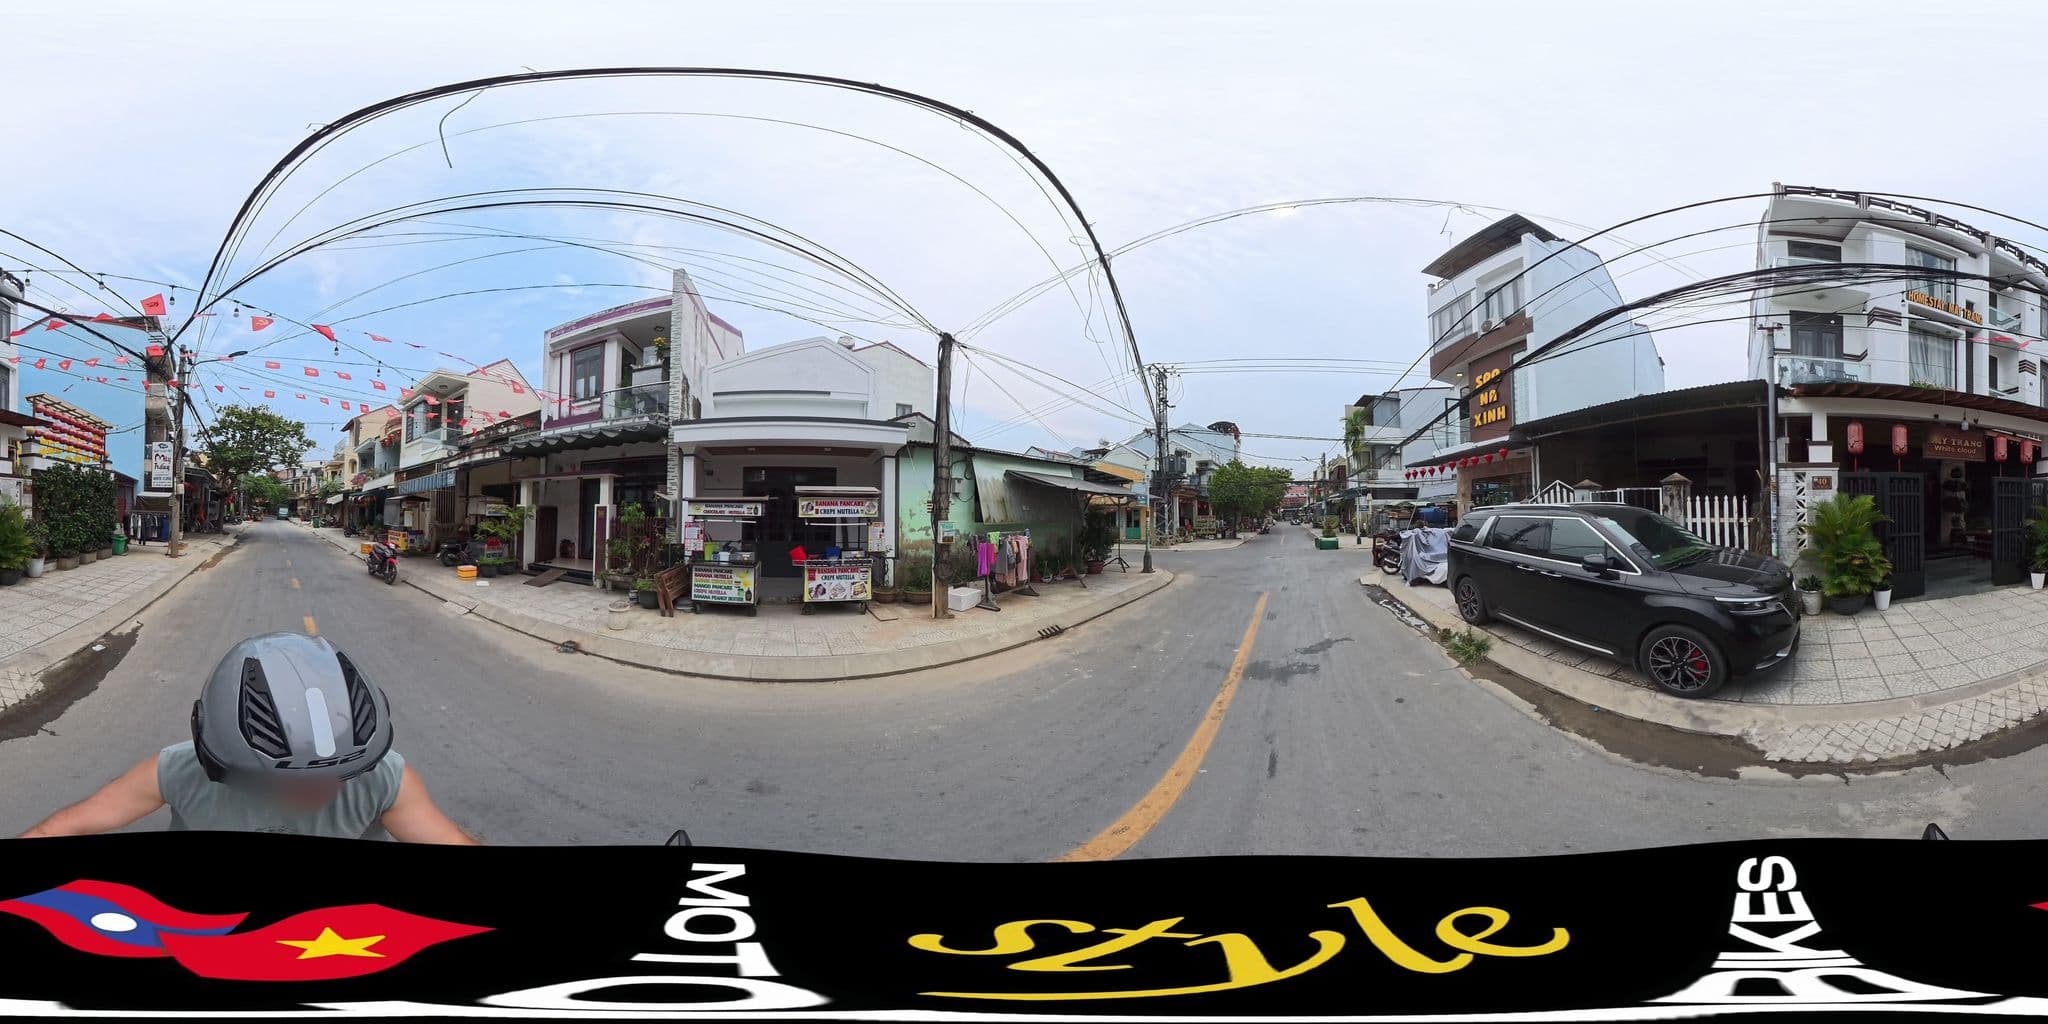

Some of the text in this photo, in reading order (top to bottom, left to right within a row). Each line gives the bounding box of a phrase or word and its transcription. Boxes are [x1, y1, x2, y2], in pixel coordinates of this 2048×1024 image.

[1908, 290, 1945, 311] HOMESTAY
[1474, 405, 1506, 428] XINH
[275, 748, 367, 770] LS2
